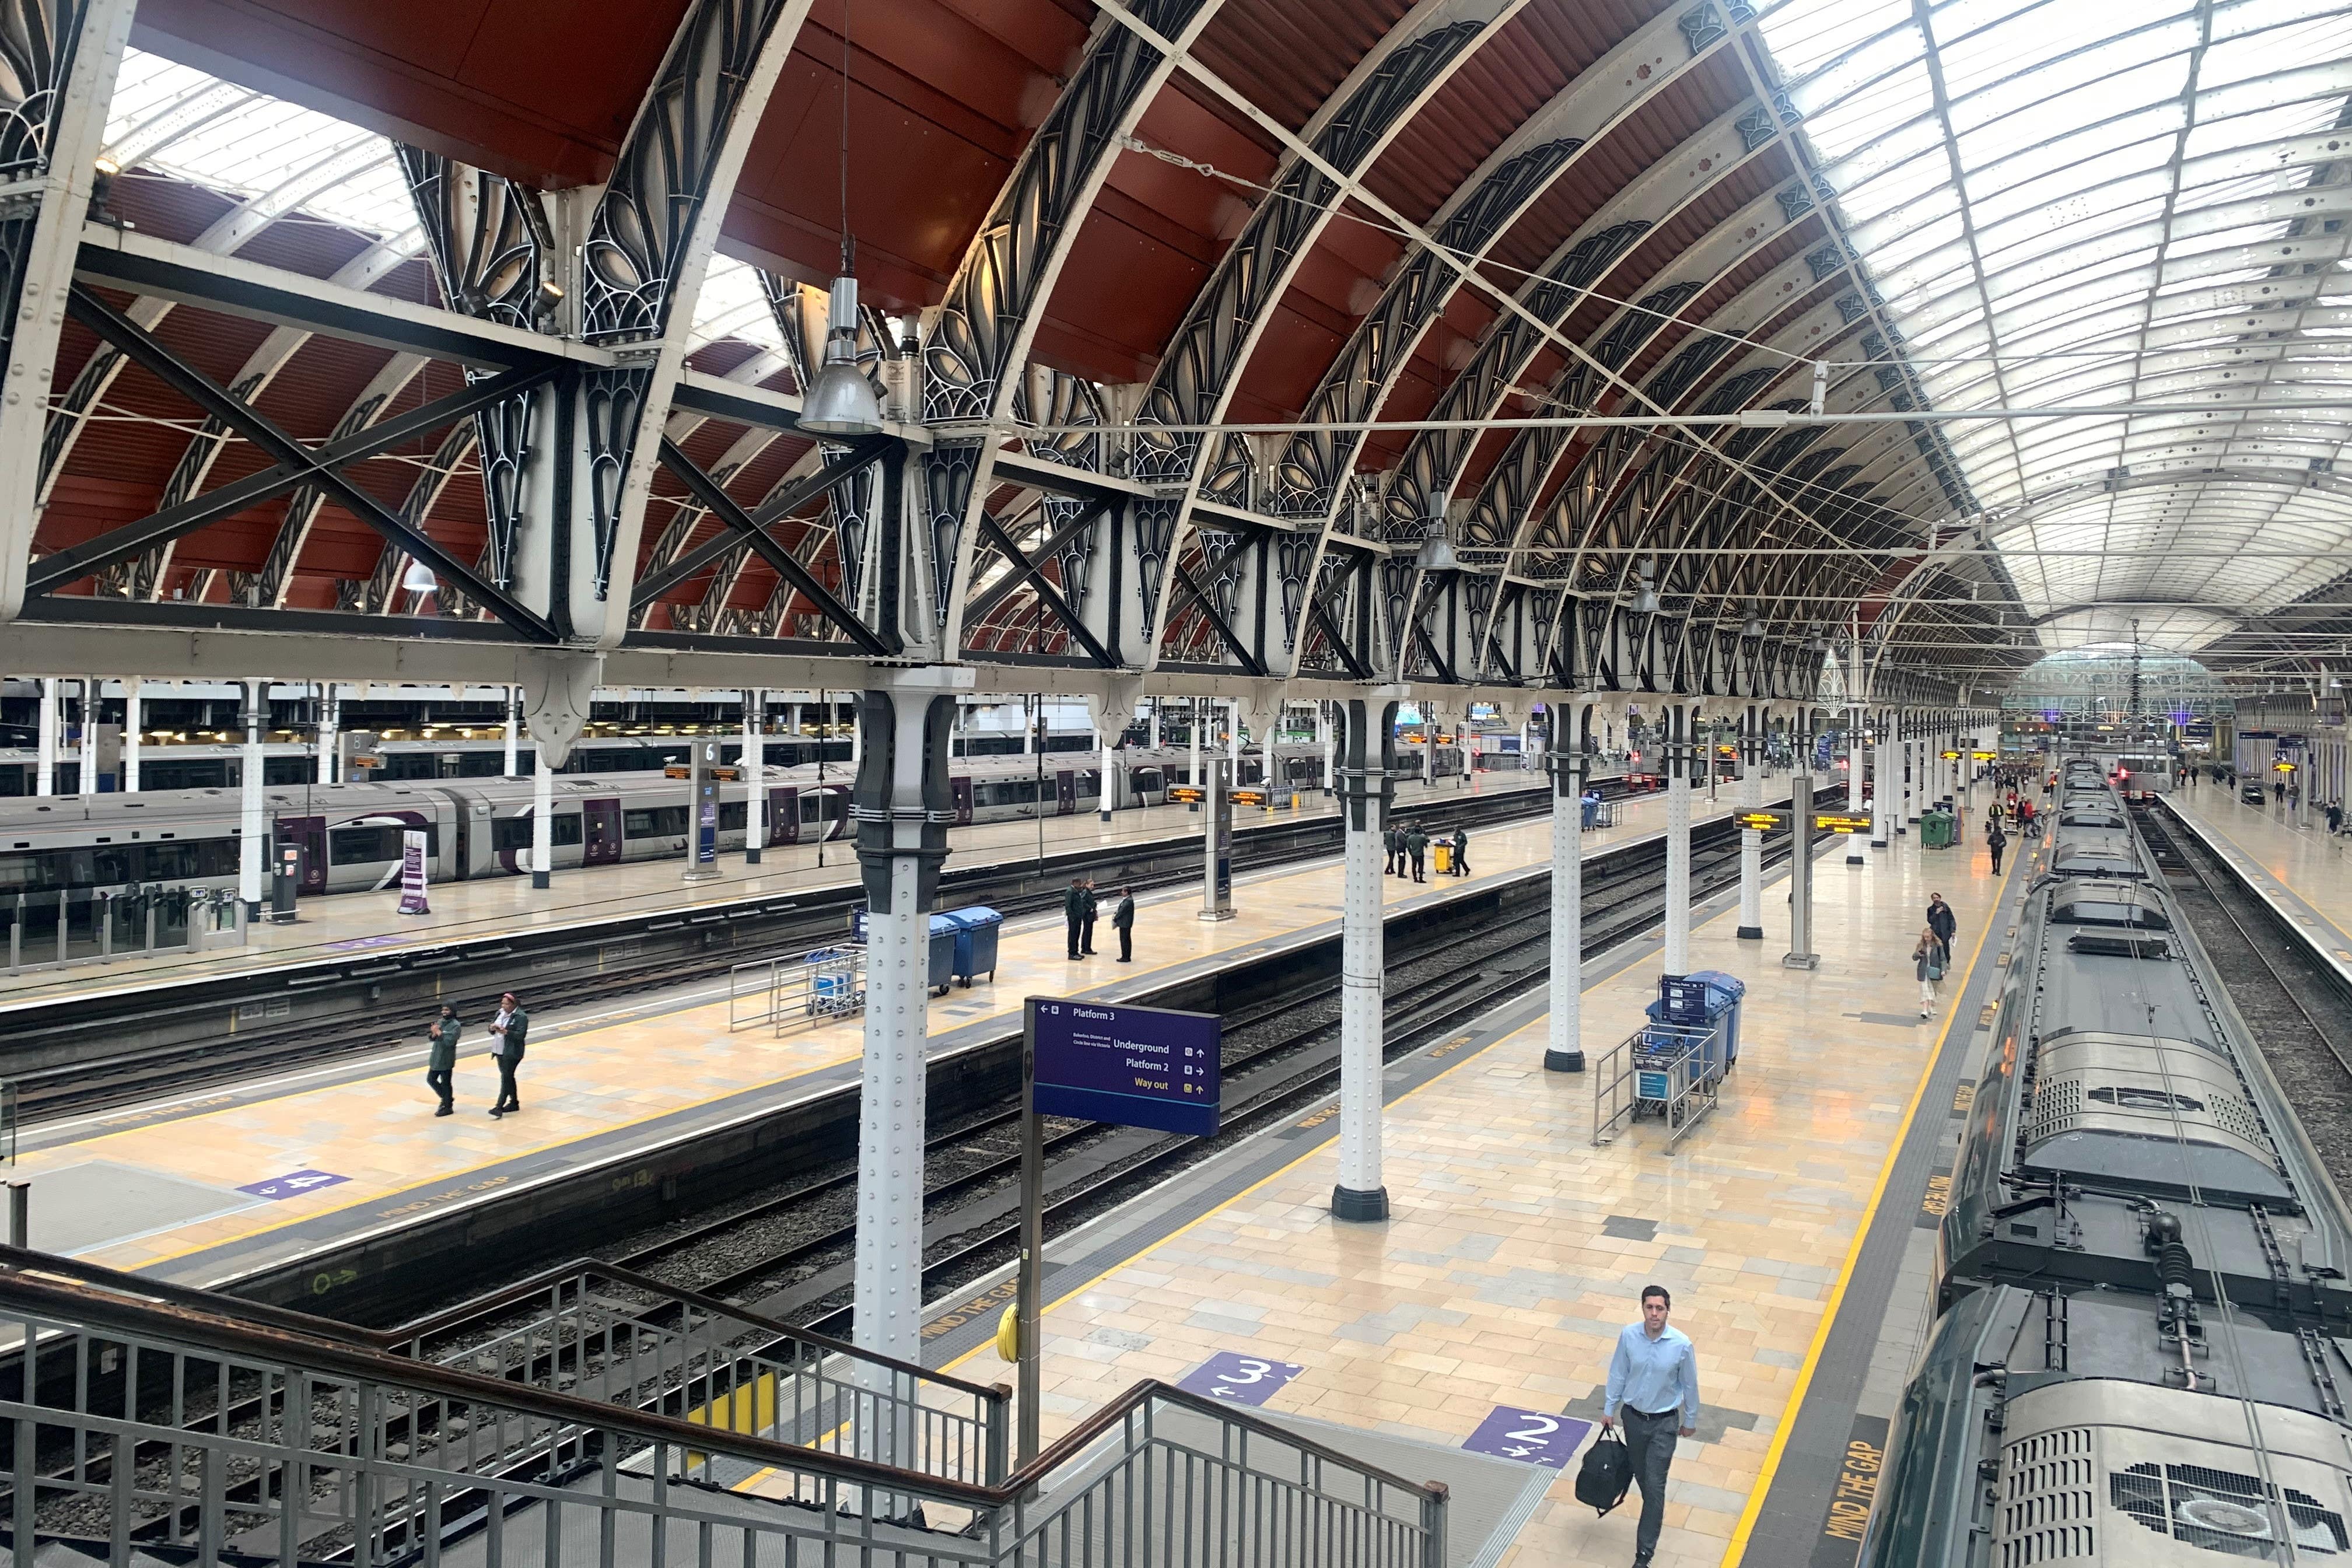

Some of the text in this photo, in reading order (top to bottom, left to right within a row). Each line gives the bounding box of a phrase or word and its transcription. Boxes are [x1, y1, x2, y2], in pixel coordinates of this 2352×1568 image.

[354, 735, 360, 750] 8
[706, 743, 713, 761] 6
[1221, 761, 1228, 780] 4
[1073, 1008, 1115, 1020] Platform 3
[1114, 1039, 1170, 1054] Underground
[1126, 1058, 1169, 1072] Platform 2
[1135, 1077, 1168, 1090] Way out
[284, 1175, 333, 1189] 4
[376, 1175, 510, 1219] MIND THE GAP
[921, 1314, 967, 1339] MIND
[955, 1297, 1000, 1315] THE
[1216, 1359, 1272, 1384] 3
[1504, 1415, 1559, 1446] 2
[1825, 1440, 1884, 1542] MIND THE GAP
